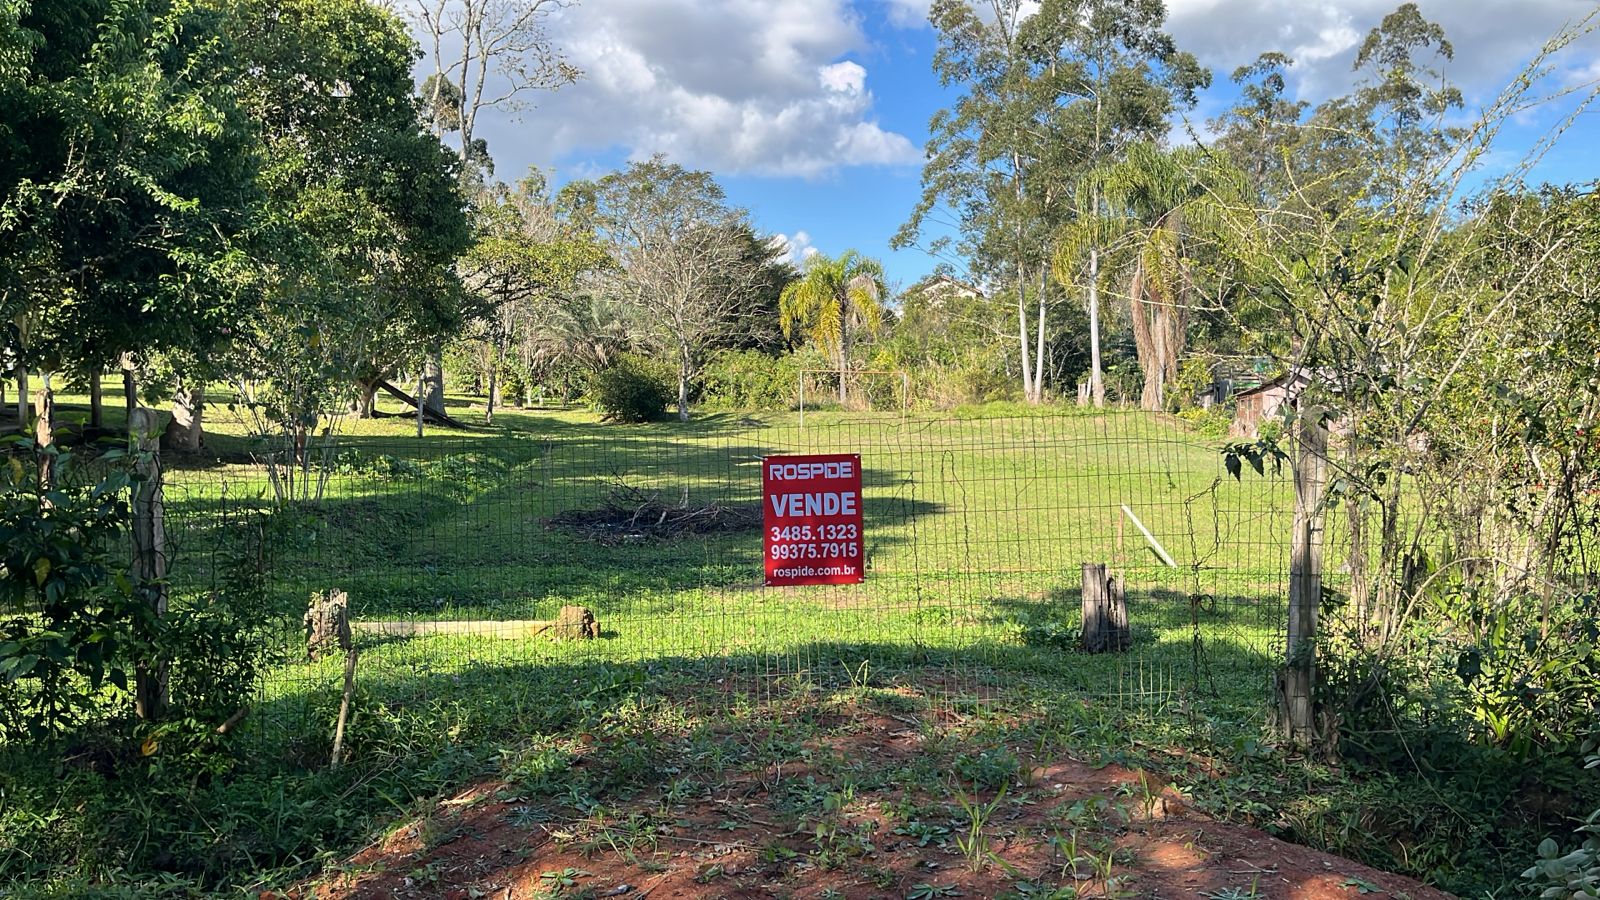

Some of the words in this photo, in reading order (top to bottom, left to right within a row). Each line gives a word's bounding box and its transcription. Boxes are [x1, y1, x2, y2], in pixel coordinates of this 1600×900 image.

[769, 461, 852, 480] ROSPIDE
[770, 492, 857, 517] VENDE
[770, 523, 857, 541] 3485.1323
[771, 542, 858, 559] 99375.7915
[773, 564, 856, 579] rospide.com.br
